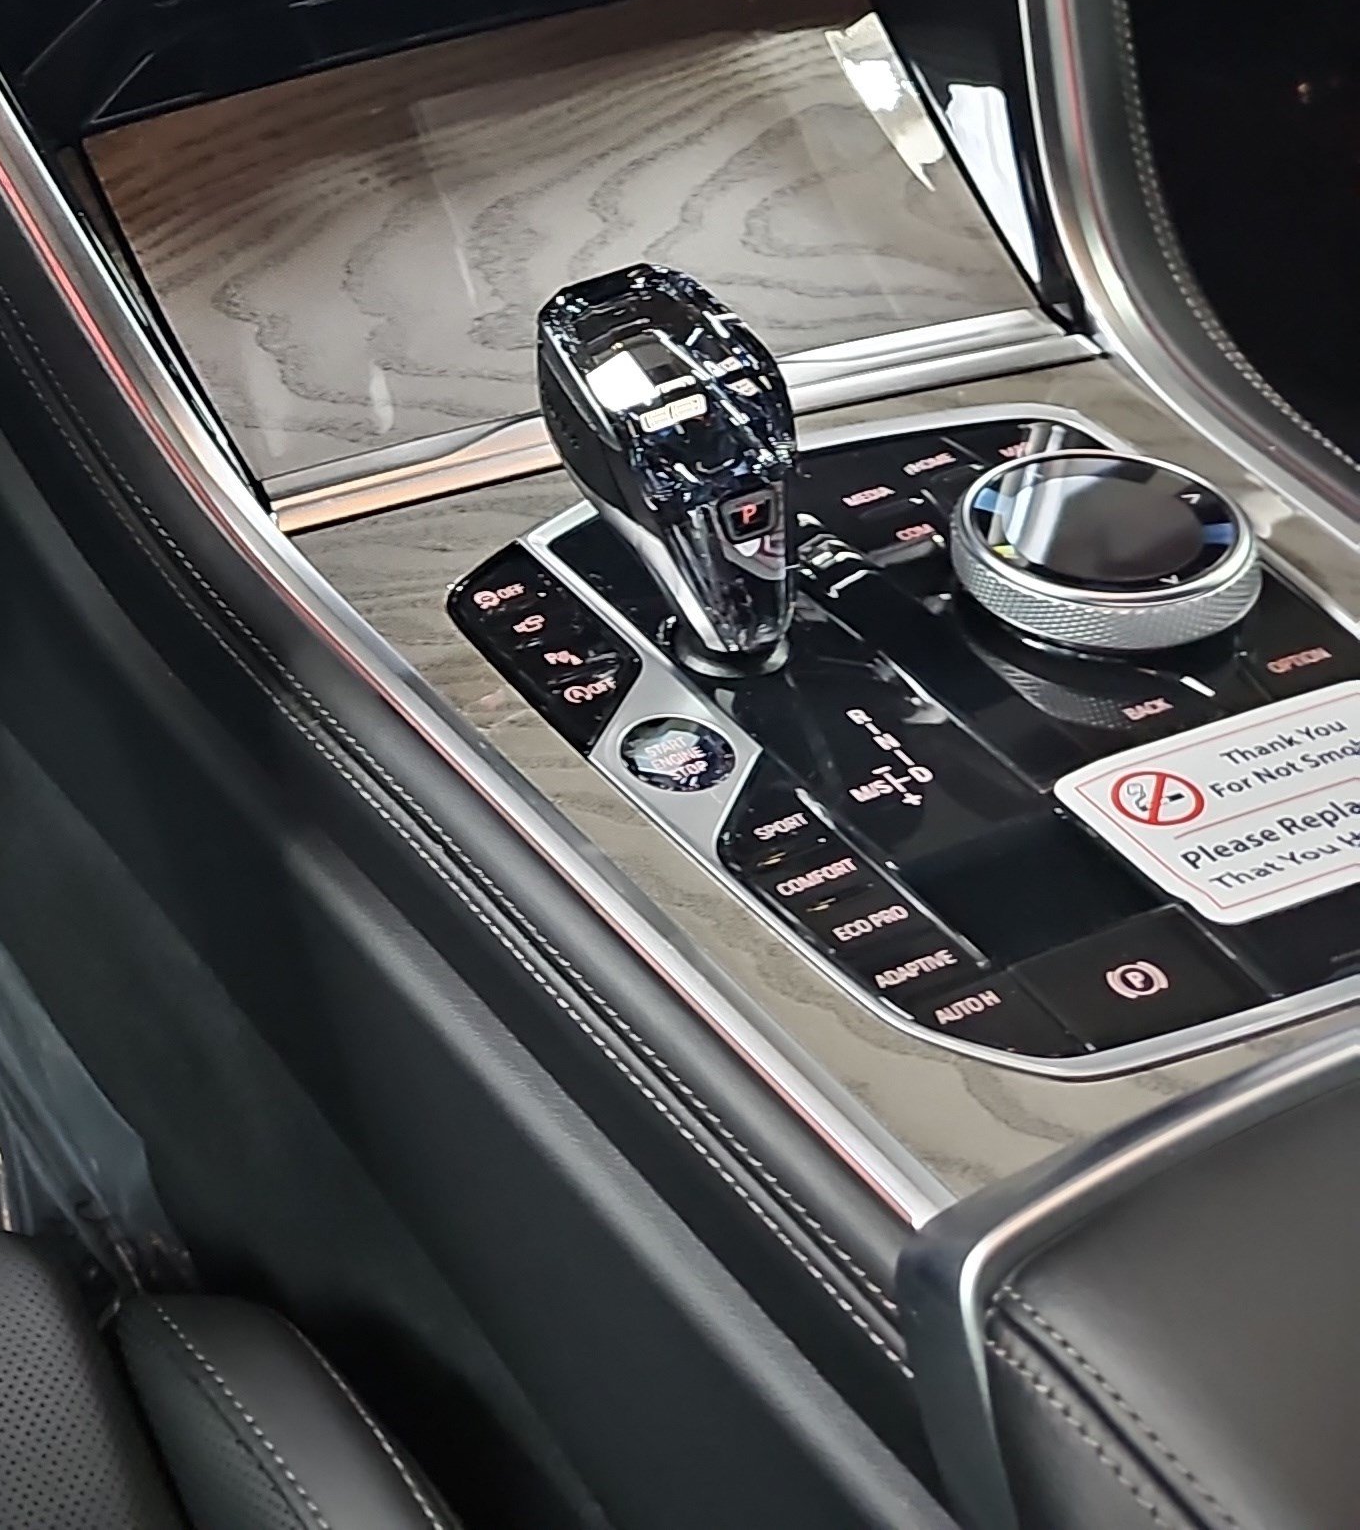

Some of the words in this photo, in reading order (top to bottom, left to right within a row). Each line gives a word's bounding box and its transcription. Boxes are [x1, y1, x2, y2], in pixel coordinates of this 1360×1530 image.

[741, 504, 758, 524] P
[496, 582, 526, 601] OFF
[1266, 647, 1332, 674] OPTION
[587, 676, 617, 695] OFF
[1121, 697, 1174, 720] BACK
[644, 736, 688, 758] START
[1220, 734, 1301, 766] Thank
[1296, 720, 1348, 741] You
[651, 746, 708, 771] ENGINE
[672, 760, 709, 781] STOP
[1209, 778, 1257, 799] For
[1251, 761, 1303, 784] Not
[753, 812, 809, 840] SPORT
[1180, 830, 1281, 870] Please
[776, 857, 858, 897] COMFORT
[1209, 859, 1279, 889] That
[1275, 844, 1341, 865] You
[831, 919, 874, 942] ECO
[868, 904, 910, 928] PRO
[874, 949, 959, 988] ADAPTIVE
[934, 996, 984, 1025] AUTO
[978, 990, 1002, 1009] H
